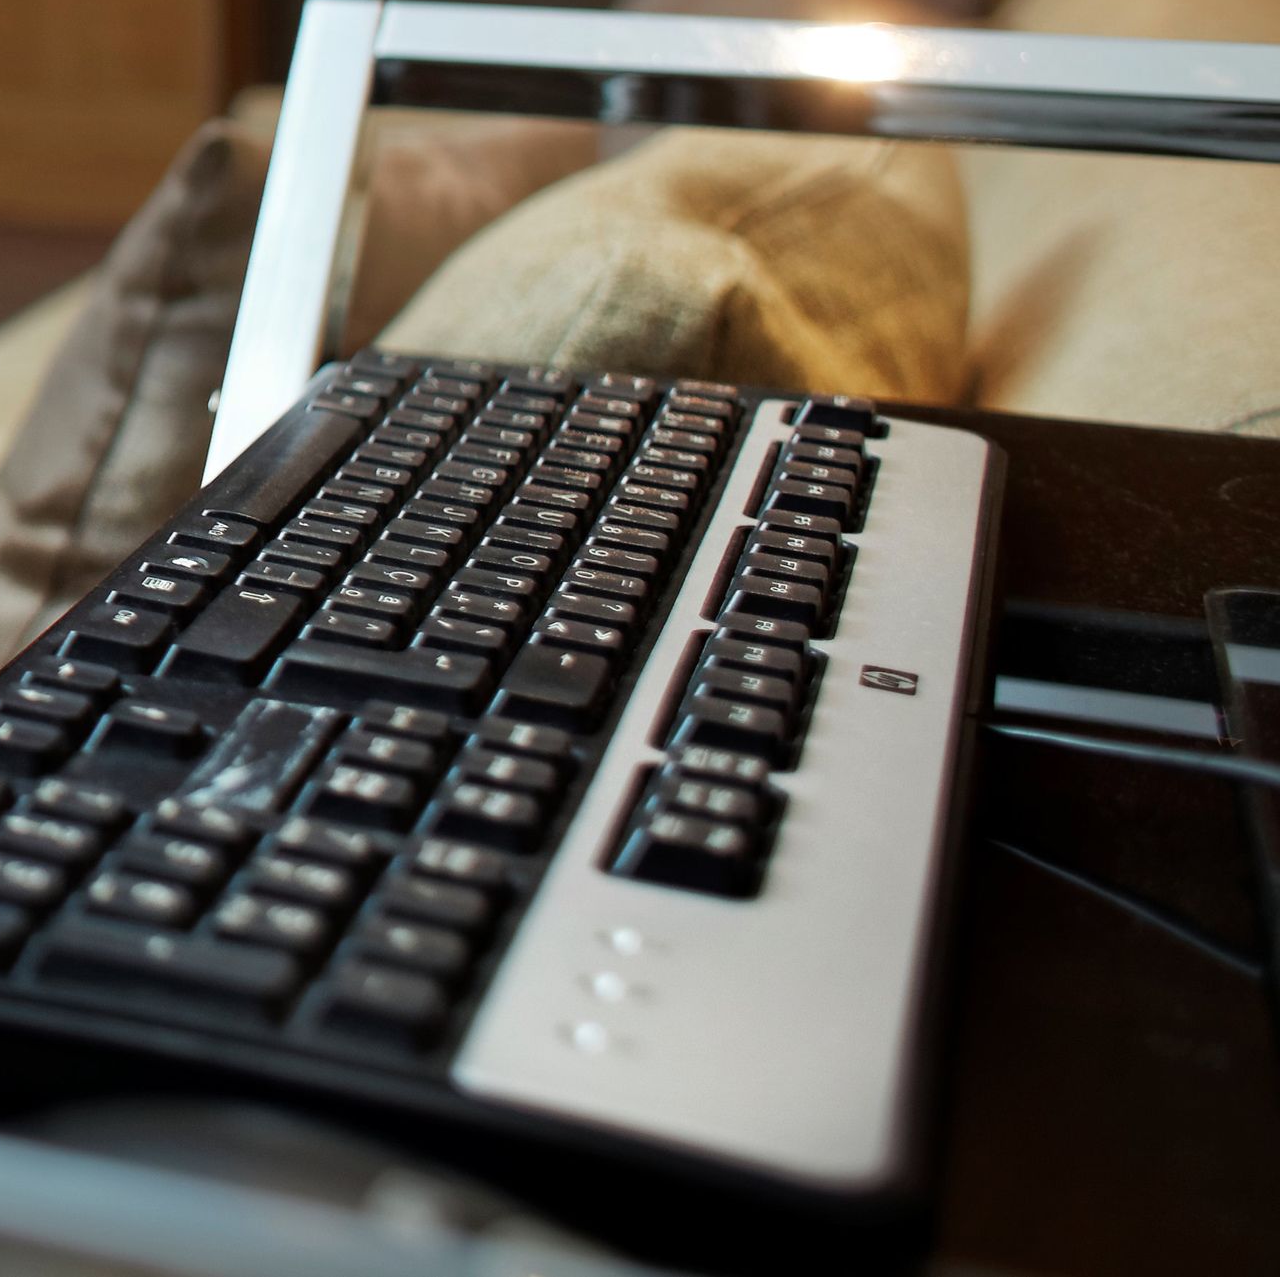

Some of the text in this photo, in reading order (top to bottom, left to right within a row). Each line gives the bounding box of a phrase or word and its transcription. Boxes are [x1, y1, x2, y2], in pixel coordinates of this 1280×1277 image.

[376, 468, 400, 479] B
[473, 468, 496, 480] G
[634, 466, 653, 475] 5
[359, 487, 384, 497] N
[460, 486, 484, 498] H
[624, 486, 645, 495] 6
[552, 494, 578, 502] Y
[344, 506, 366, 518] M
[443, 507, 466, 517] J
[614, 506, 633, 515] 7
[537, 511, 564, 523] U
[794, 516, 811, 525] F5
[426, 527, 452, 537] K
[602, 525, 622, 534] 8
[788, 538, 804, 547] F6
[410, 547, 437, 556] L
[589, 548, 608, 557] 9
[512, 556, 538, 565] O
[780, 560, 797, 570] F7
[384, 571, 418, 582] Ç
[575, 571, 596, 579] 0
[497, 577, 523, 587] P
[771, 582, 789, 593] F8
[601, 604, 623, 612] ?
[756, 620, 774, 631] F9
[744, 646, 765, 662] F10
[861, 669, 917, 691] hp
